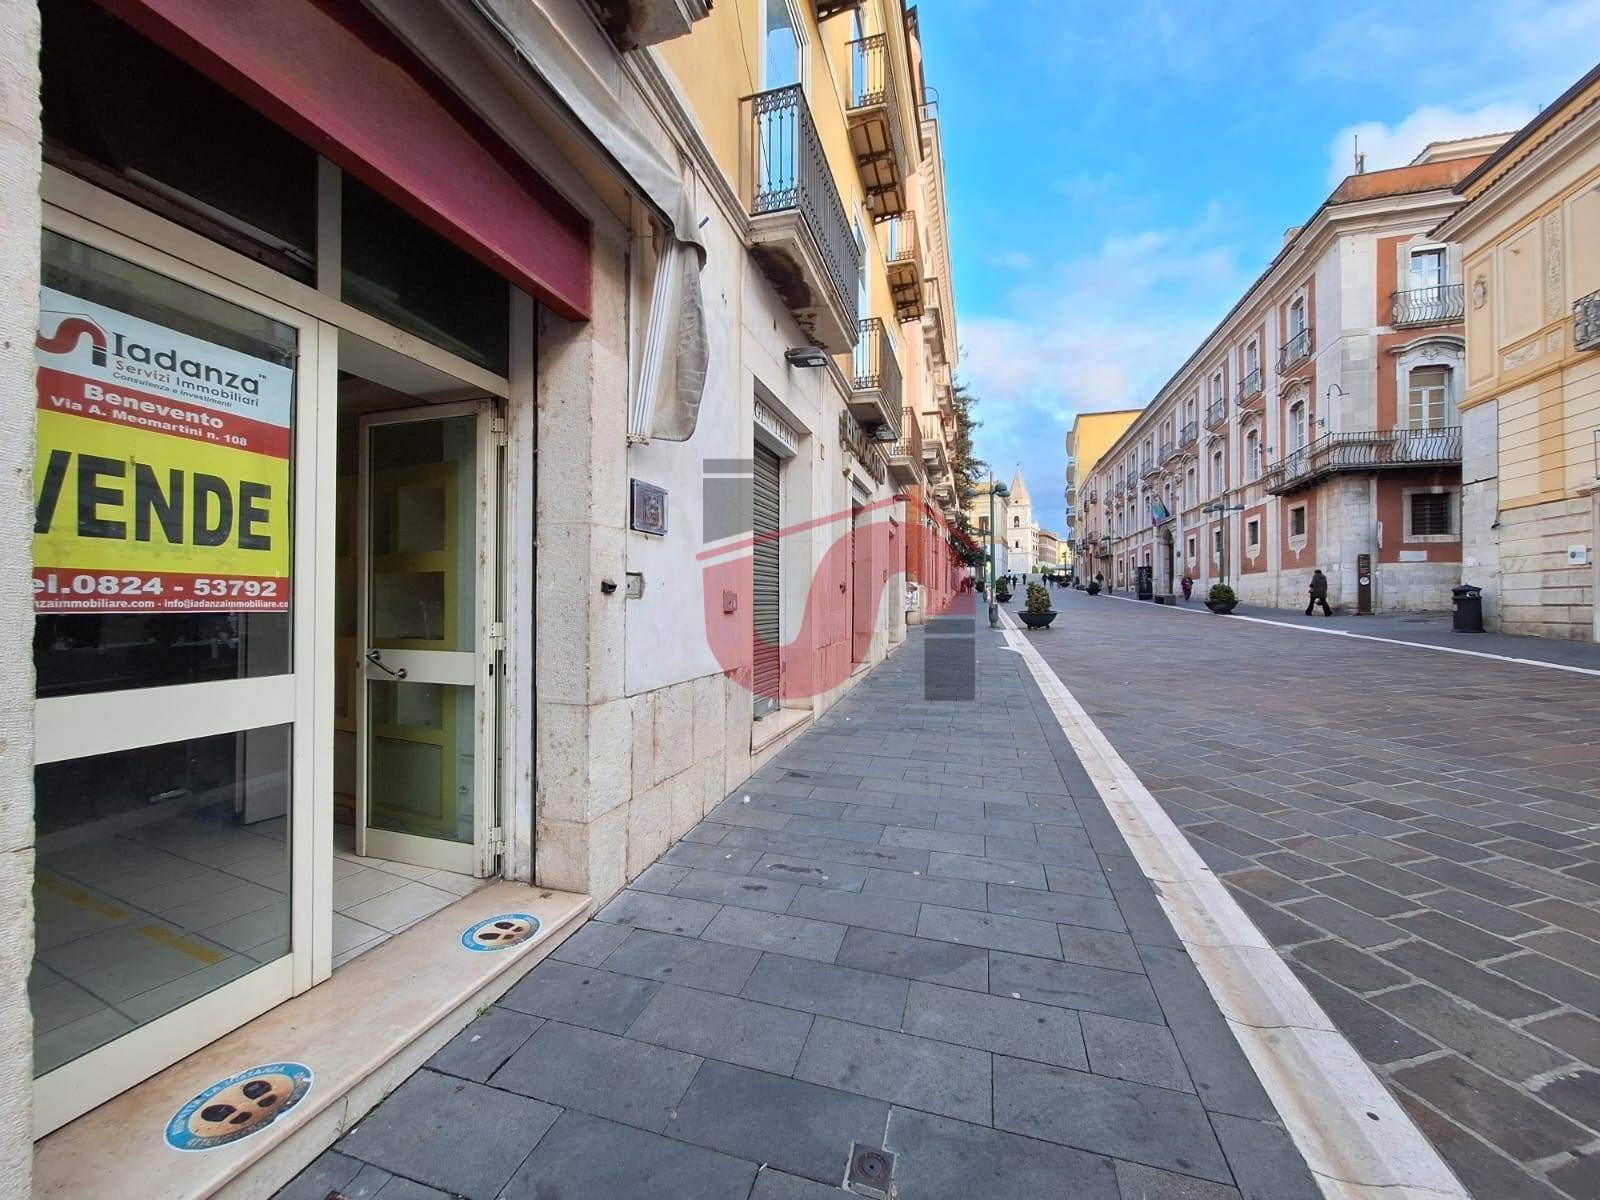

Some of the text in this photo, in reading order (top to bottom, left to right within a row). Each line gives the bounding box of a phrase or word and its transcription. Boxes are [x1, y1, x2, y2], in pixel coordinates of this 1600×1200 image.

[112, 331, 259, 395] Iadanza
[112, 371, 170, 392] Consulenza
[115, 358, 259, 408] Servizi Immobiliari
[50, 394, 248, 447] Via A. Meomartini n. 108
[83, 382, 224, 429] Benevento
[34, 449, 271, 551] VENDE
[193, 578, 277, 597] 53792
